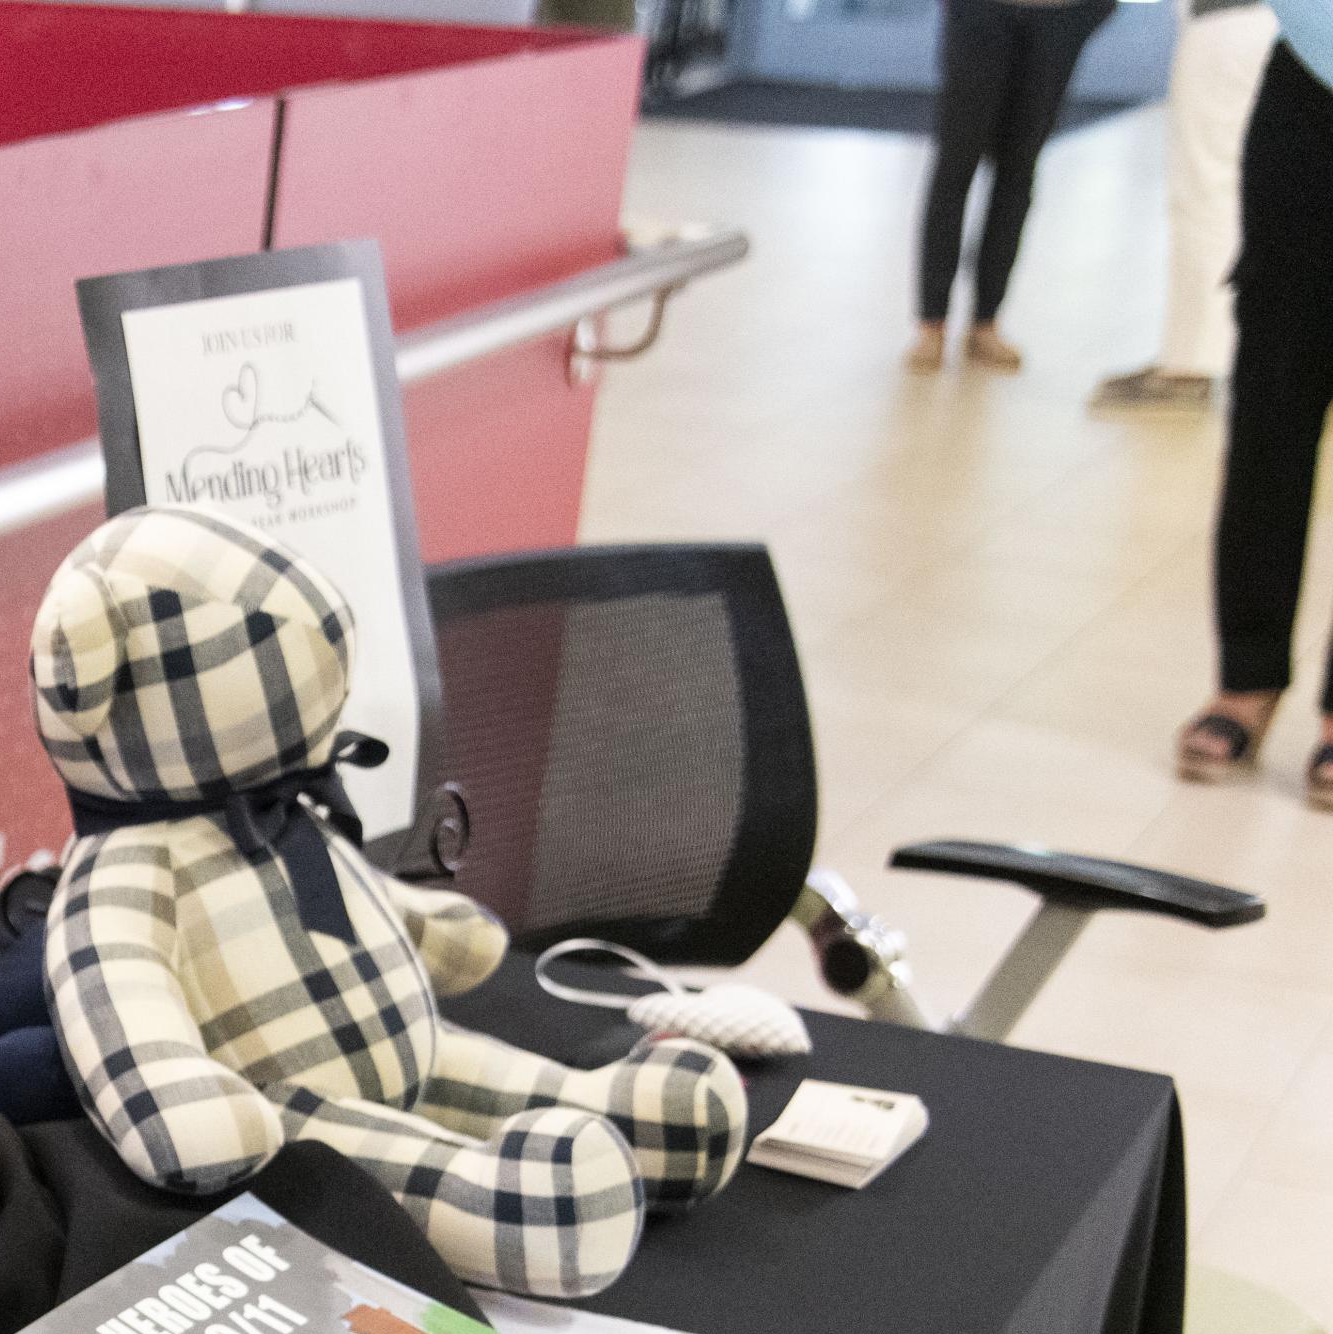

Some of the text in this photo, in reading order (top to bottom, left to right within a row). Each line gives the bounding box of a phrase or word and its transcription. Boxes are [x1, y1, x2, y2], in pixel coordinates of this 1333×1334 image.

[164, 437, 366, 509] Mending Hearts
[222, 1233, 291, 1282] OF
